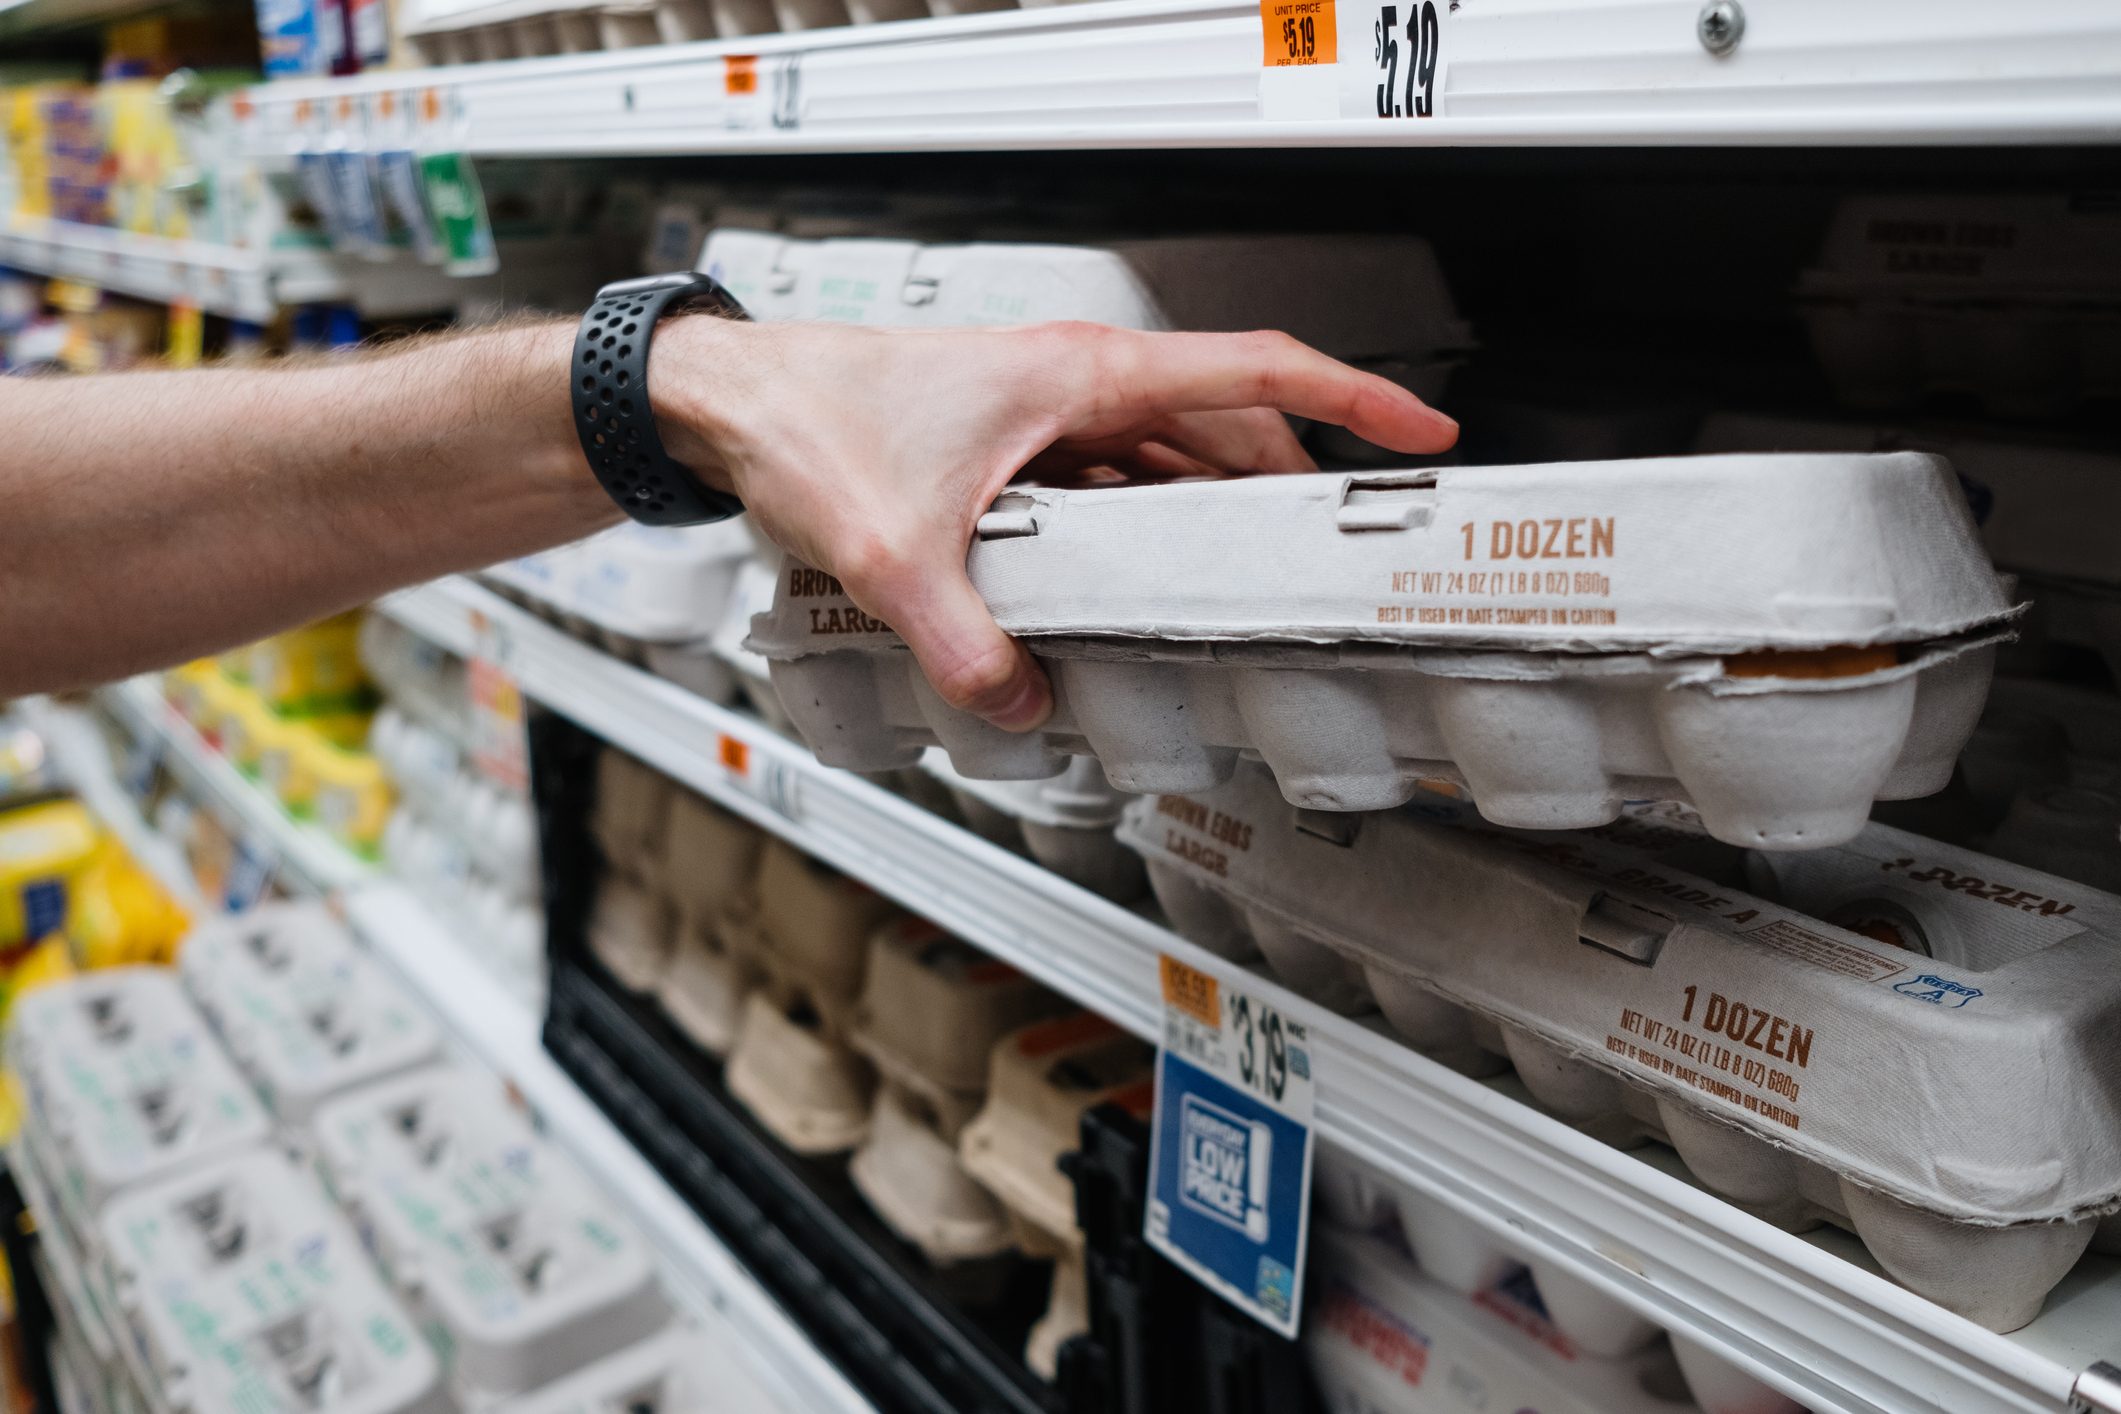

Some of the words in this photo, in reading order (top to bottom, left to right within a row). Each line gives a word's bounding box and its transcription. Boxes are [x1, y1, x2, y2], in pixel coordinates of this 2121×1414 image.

[1275, 5, 1292, 16] UNIT
[1295, 3, 1321, 15] PRICE
[1277, 58, 1291, 67] PER
[1298, 57, 1318, 66] EACH
[1283, 16, 1315, 58] $5.19
[1375, 1, 1439, 118] $5.19
[1461, 521, 1474, 560] 1
[1490, 517, 1615, 560] DOZEN
[1392, 571, 1417, 593] NET
[1421, 571, 1442, 593] WT
[1446, 571, 1464, 594] 24
[1468, 571, 1487, 594] OZ
[1509, 571, 1526, 594] LB
[1532, 571, 1540, 594] 8
[1377, 606, 1401, 623] BEST
[1406, 606, 1414, 623] IF
[1419, 607, 1445, 623] USED
[1449, 607, 1463, 624] BY
[1466, 607, 1492, 624] DATE
[1496, 607, 1547, 624] STAMPED
[1551, 607, 1567, 624] ON
[1571, 607, 1616, 625] CARTON
[1612, 867, 1732, 911] GRADE
[1722, 907, 1761, 926] A
[1908, 866, 2077, 917] DOZEN
[1682, 985, 1697, 1022] 1
[1704, 992, 1814, 1069] DOZEN
[1620, 1008, 1643, 1034] NET
[1644, 1017, 1663, 1042] WT
[1664, 1026, 1680, 1050] 24
[1680, 1033, 1698, 1058] OZ
[1698, 1040, 1711, 1064] (1
[1713, 1046, 1730, 1071] LB
[1733, 1055, 1742, 1076] 8
[1744, 1060, 1766, 1088] OZ)
[1767, 1069, 1800, 1103] 680g
[1606, 1035, 1625, 1054] BEST
[1628, 1045, 1637, 1060] IF
[1638, 1049, 1660, 1071] USED
[1662, 1058, 1674, 1076] BY
[1675, 1064, 1699, 1088] DATE
[1700, 1075, 1741, 1105] STAMPED
[1744, 1094, 1759, 1112] ON
[1760, 1101, 1800, 1130] CARTON
[1187, 1132, 1246, 1188] LOW
